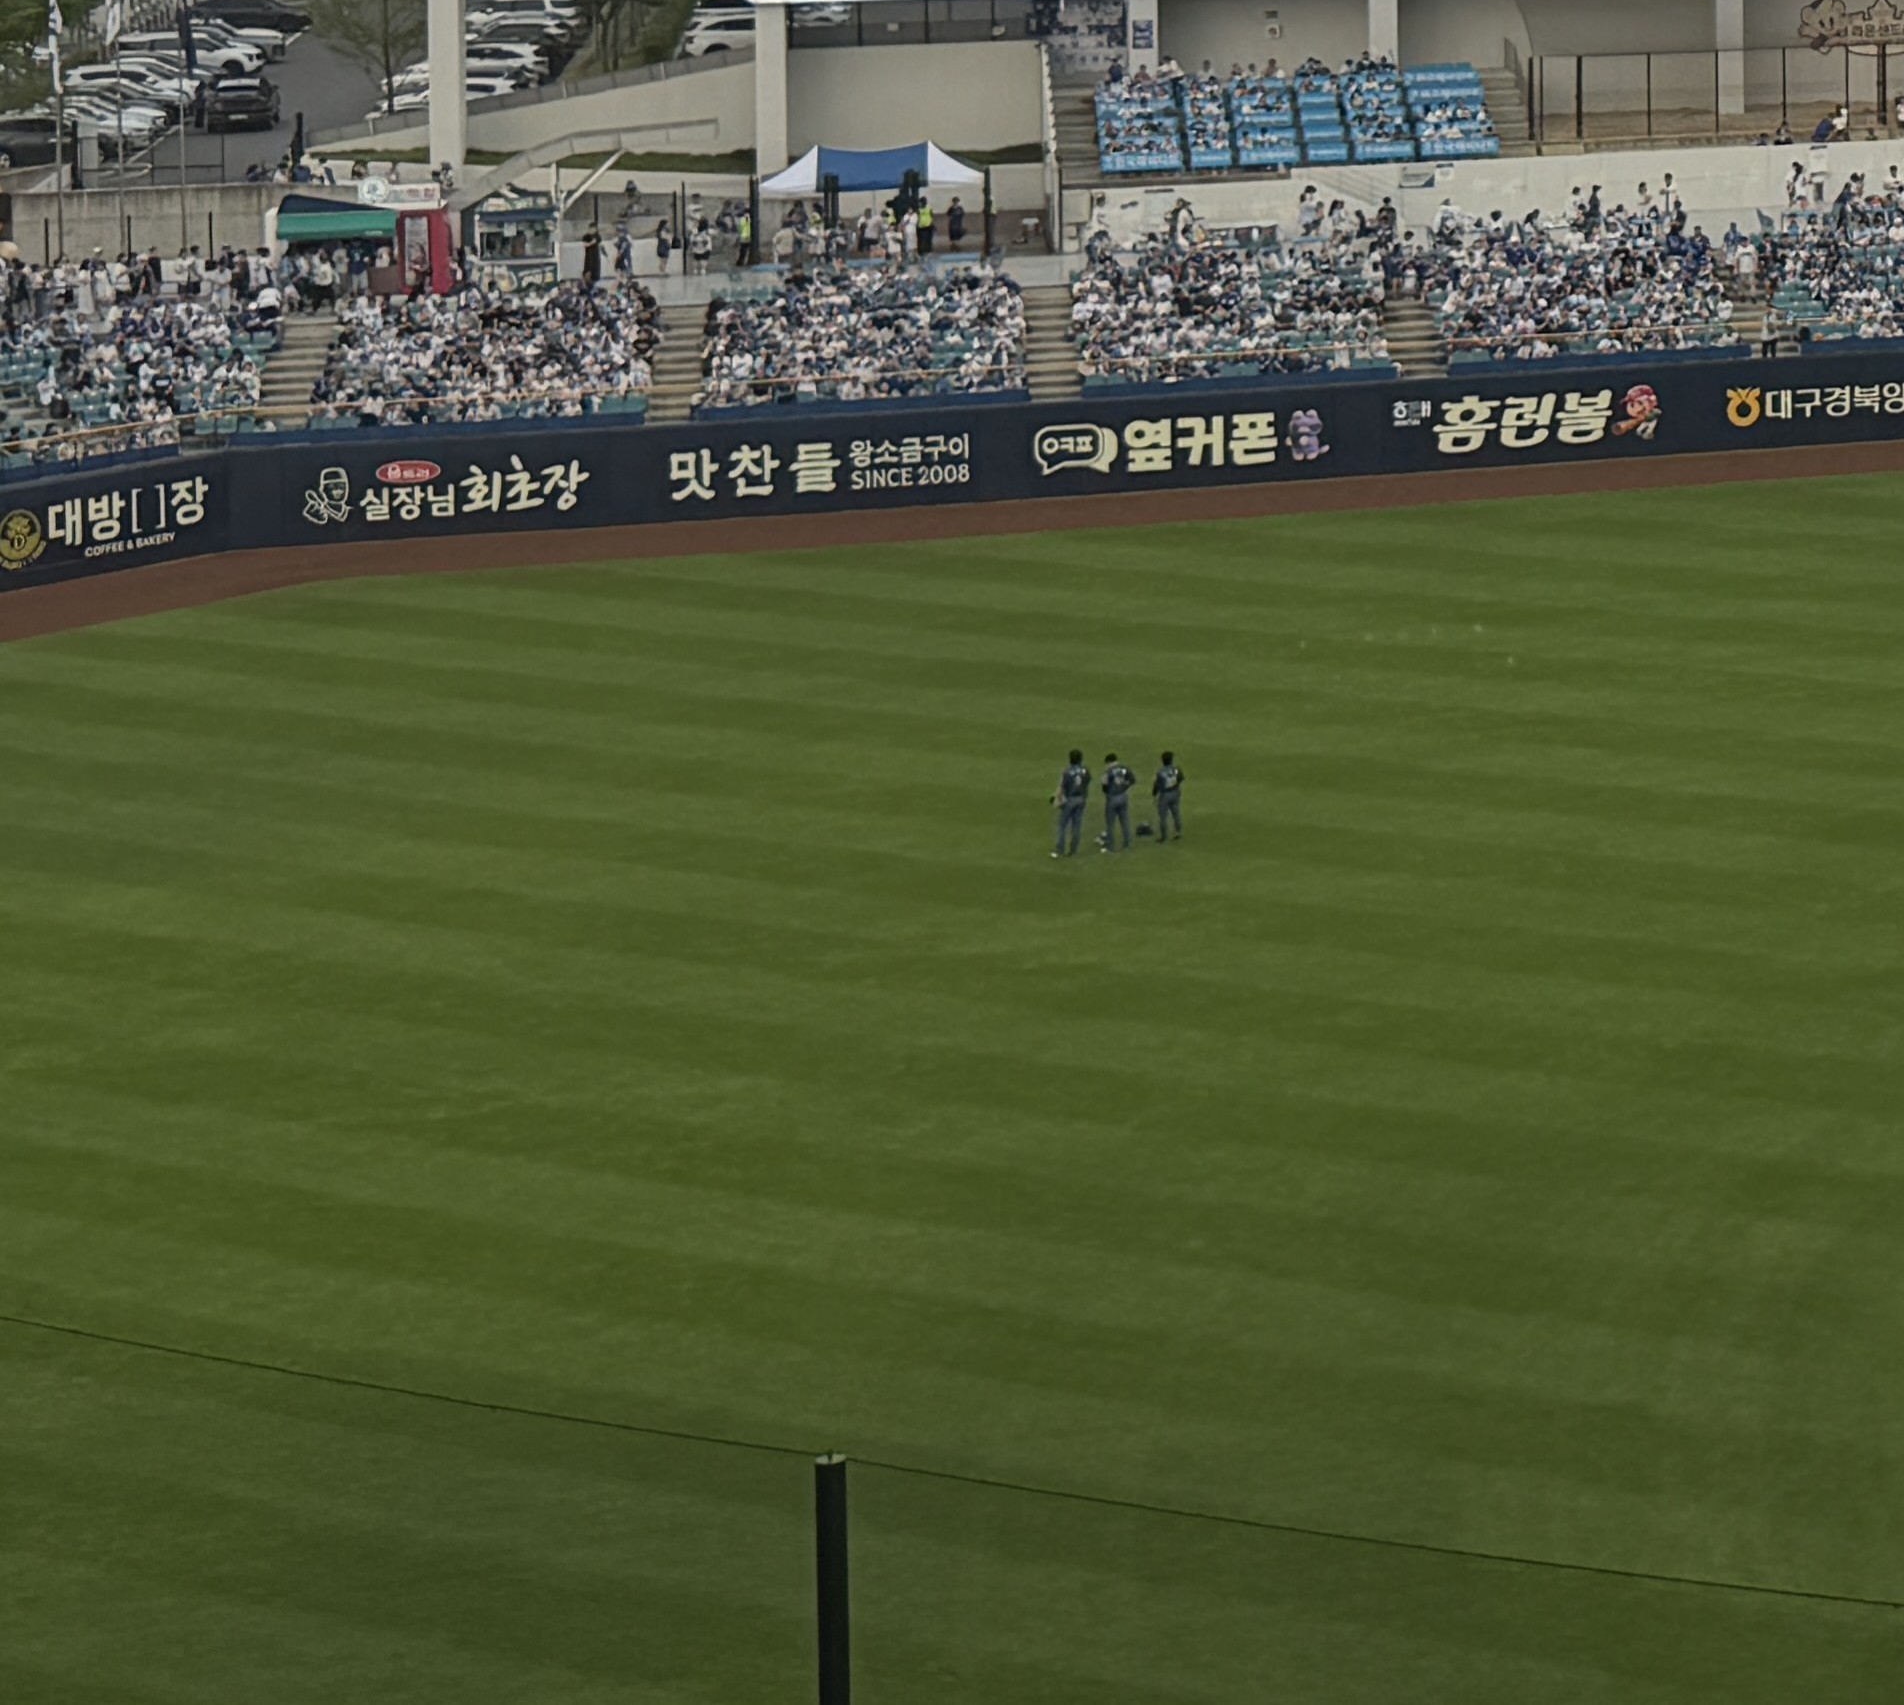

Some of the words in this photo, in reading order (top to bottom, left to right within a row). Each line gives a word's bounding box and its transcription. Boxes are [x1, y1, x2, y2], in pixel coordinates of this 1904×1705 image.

[1125, 412, 1277, 472] 옆커폰
[1433, 388, 1614, 454] 홈런볼
[848, 434, 970, 468] 왕소금구이
[360, 483, 456, 523] 실장님
[459, 455, 589, 515] 회초장
[851, 469, 912, 490] SINCE
[918, 464, 970, 485] 2008
[85, 541, 125, 558] COFFEE
[135, 531, 176, 549] BAKERY
